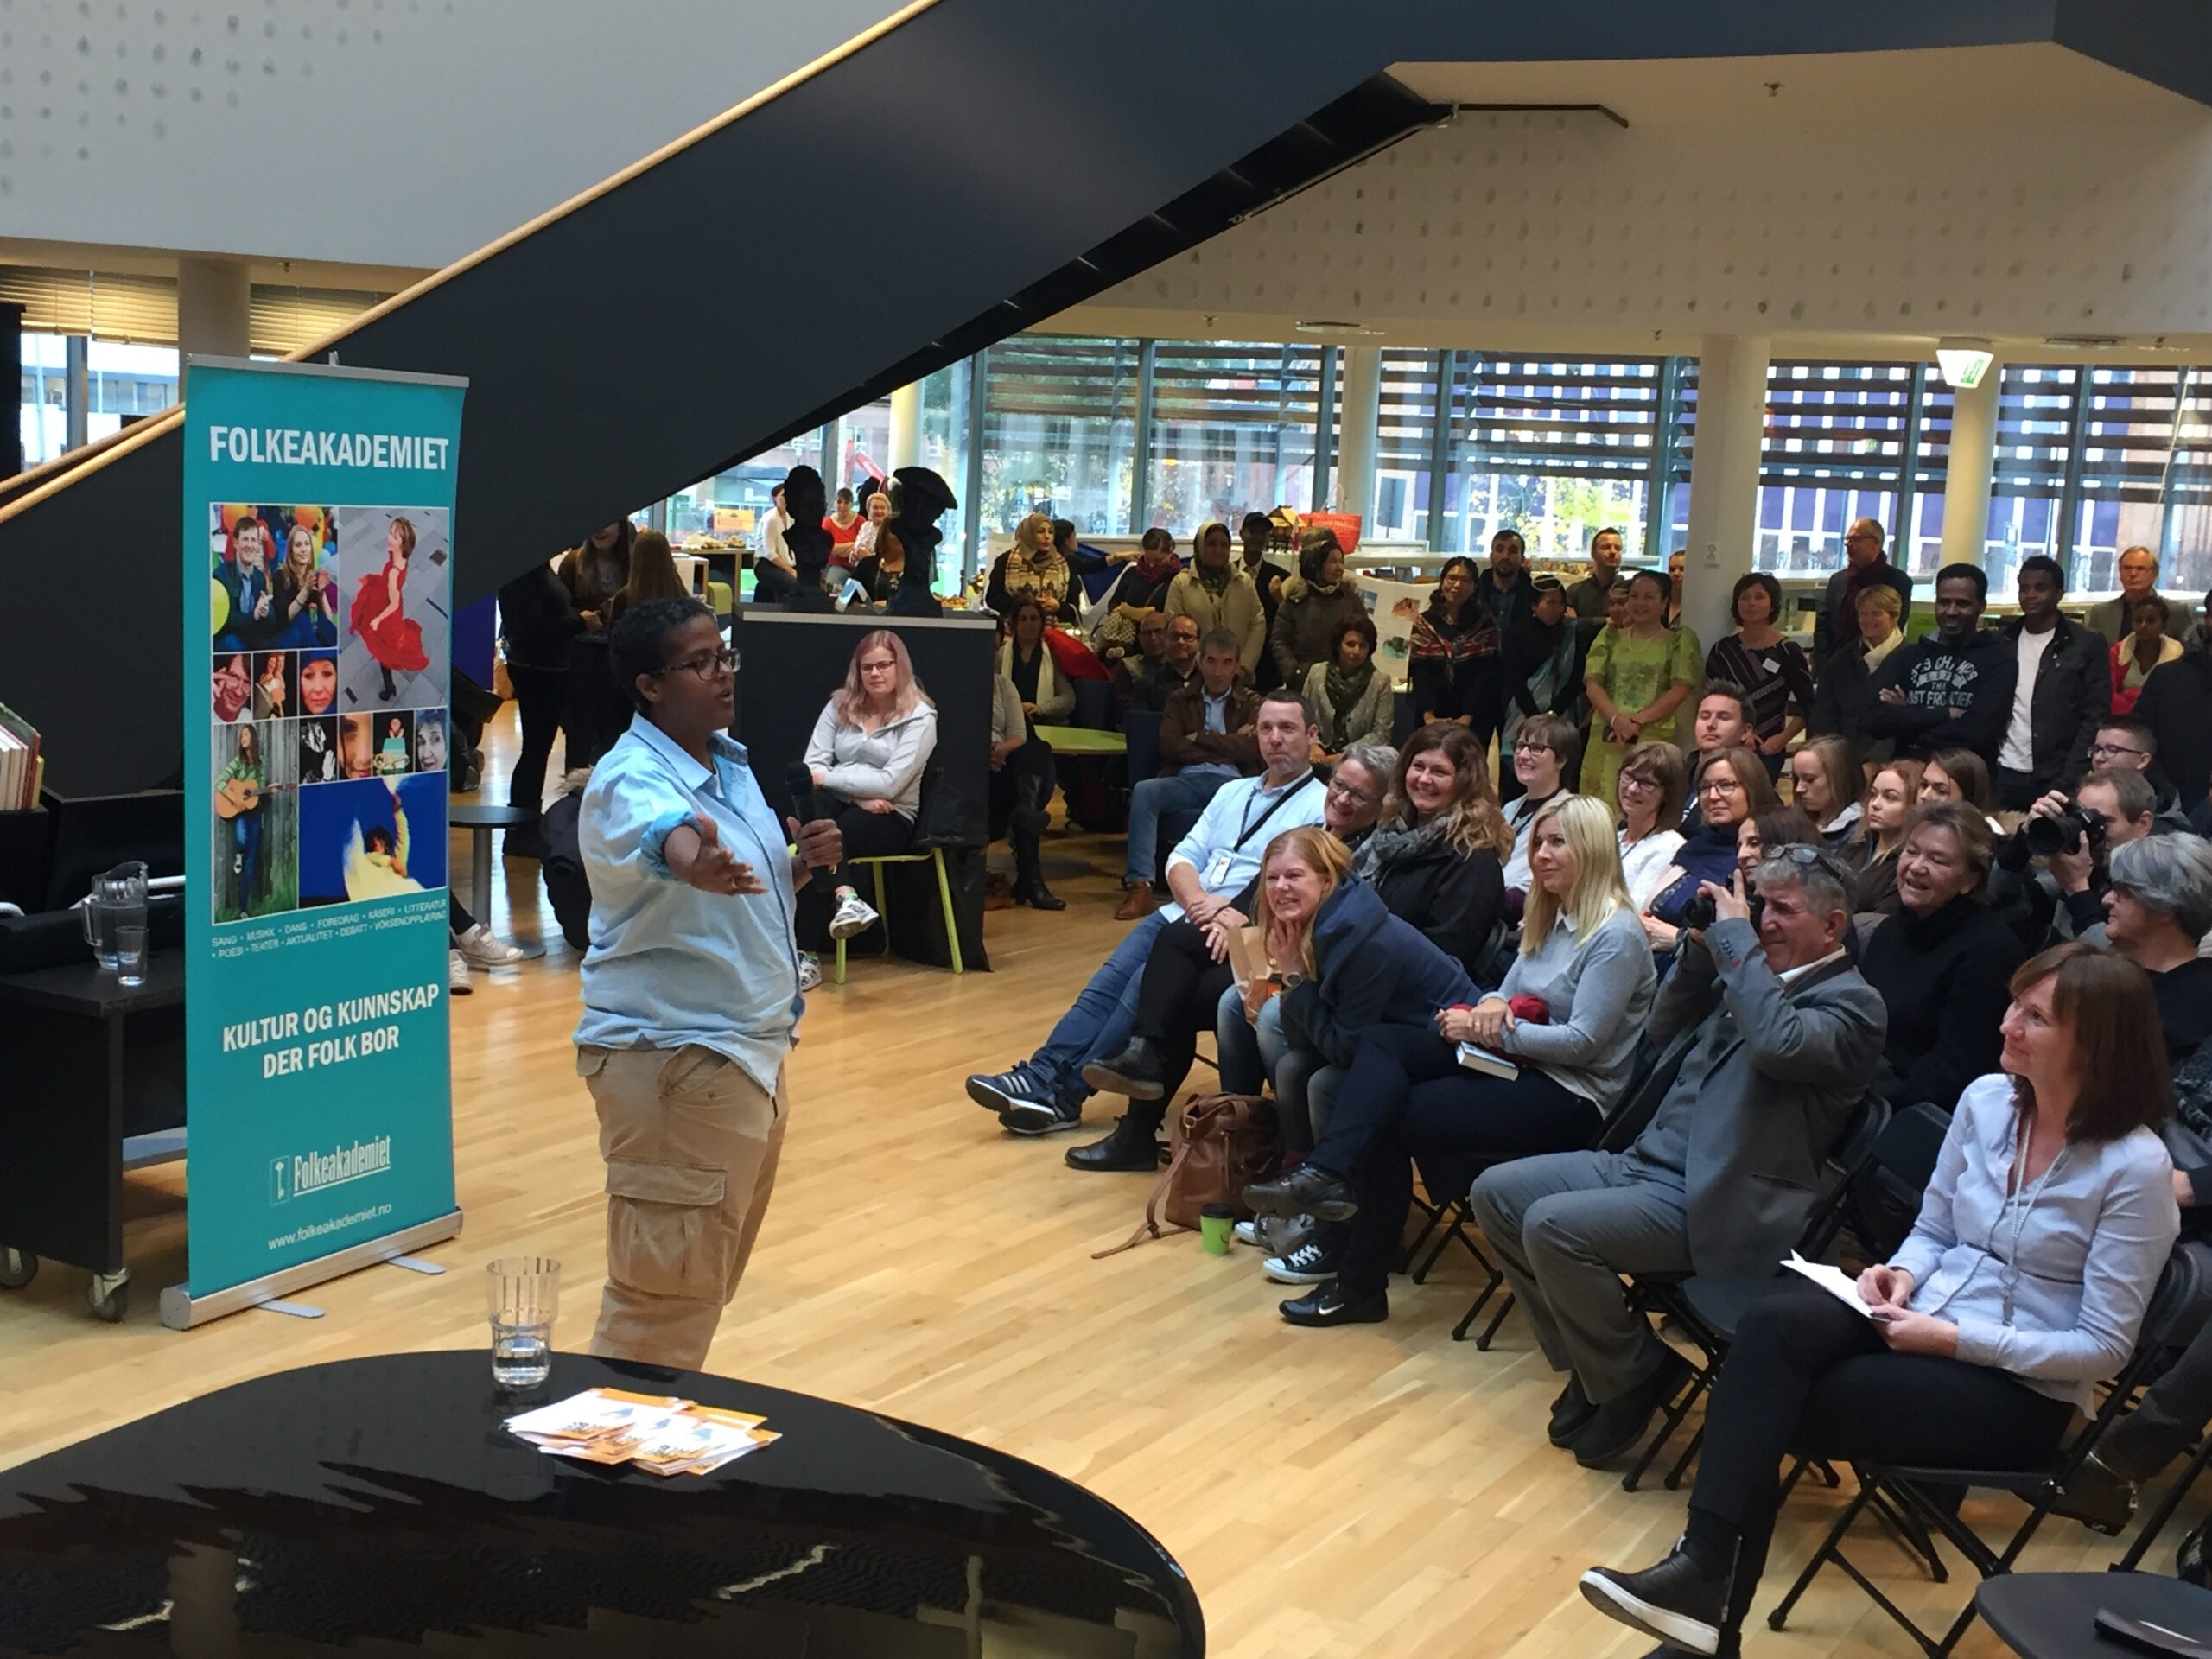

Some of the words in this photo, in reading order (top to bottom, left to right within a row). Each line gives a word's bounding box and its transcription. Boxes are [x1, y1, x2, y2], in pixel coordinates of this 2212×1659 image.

[209, 425, 449, 471] FOLKEAKADEMIET
[211, 935, 238, 947] SANG
[246, 928, 276, 942] MUSIKK
[284, 922, 308, 934] DANS
[317, 912, 360, 929] FOREDRAG
[404, 898, 447, 914] LITTERATUR
[218, 946, 244, 959] POESI
[250, 938, 280, 953] TEATER
[285, 929, 334, 947] AKTUALITET
[340, 923, 369, 938] DEBATT
[222, 1012, 299, 1052] KULTUR
[303, 1005, 333, 1033] OG
[337, 983, 440, 1027] KUNNSKAP
[263, 1046, 304, 1079] DER
[308, 1034, 357, 1069] FOLK
[360, 1025, 400, 1057] BOR
[293, 1135, 391, 1192] Folkeakademiet
[267, 1203, 392, 1251] www.folkeakademiet.no
